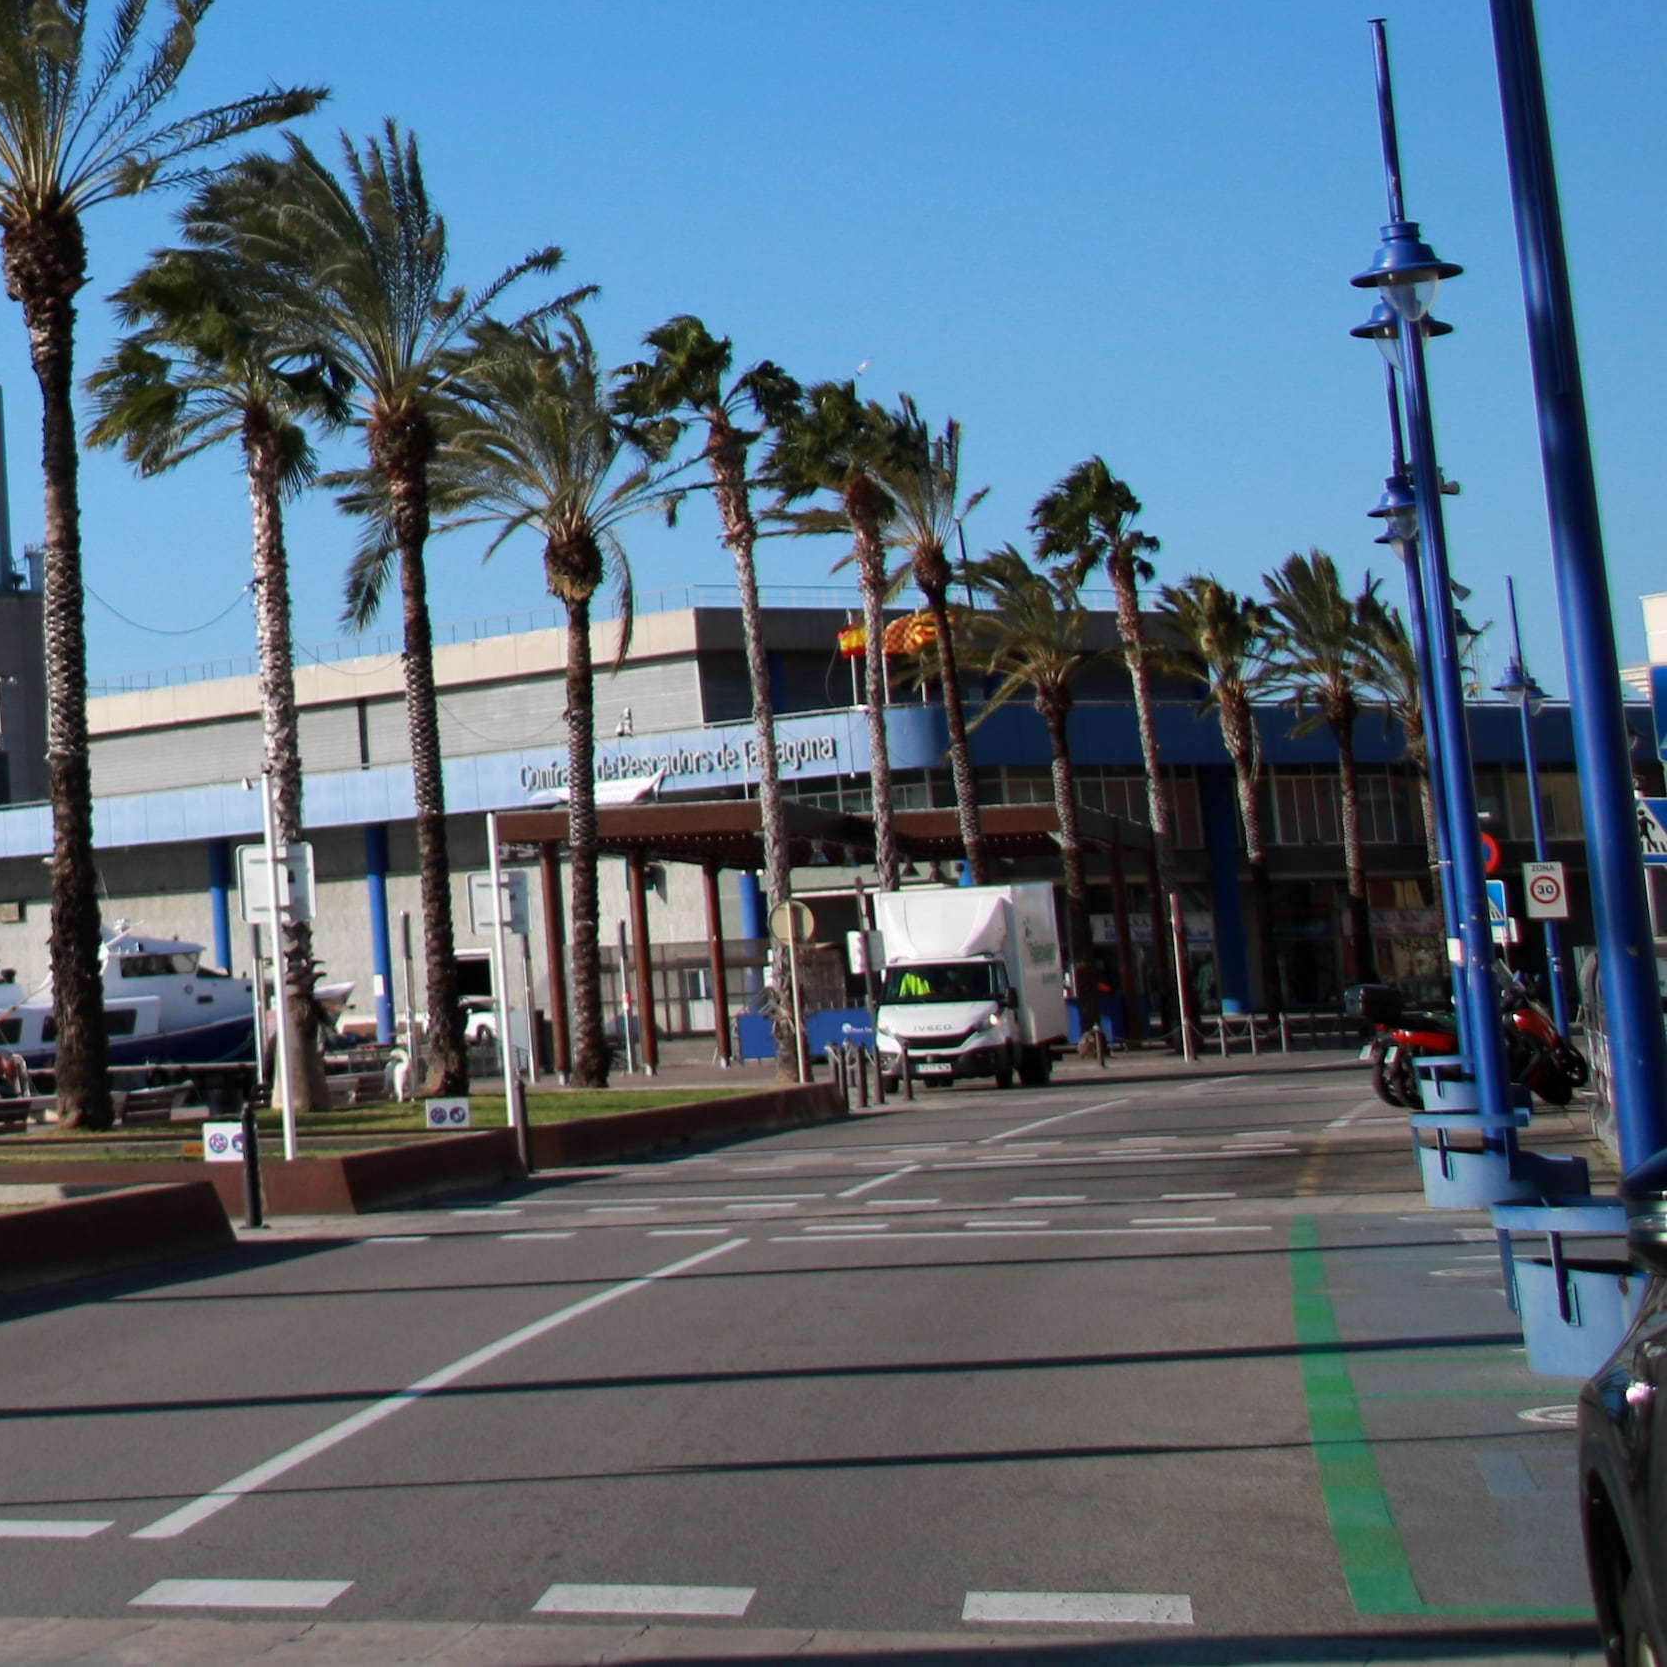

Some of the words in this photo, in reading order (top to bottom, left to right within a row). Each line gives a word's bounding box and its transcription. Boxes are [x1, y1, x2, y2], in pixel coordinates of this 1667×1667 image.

[520, 760, 570, 792] Confra
[596, 756, 617, 781] de
[618, 747, 713, 780] Pescadors
[715, 742, 739, 771] de
[742, 736, 835, 771] Taagona
[1531, 864, 1555, 872] ZONA
[1537, 884, 1554, 894] 30
[914, 1023, 953, 1032] IVECO
